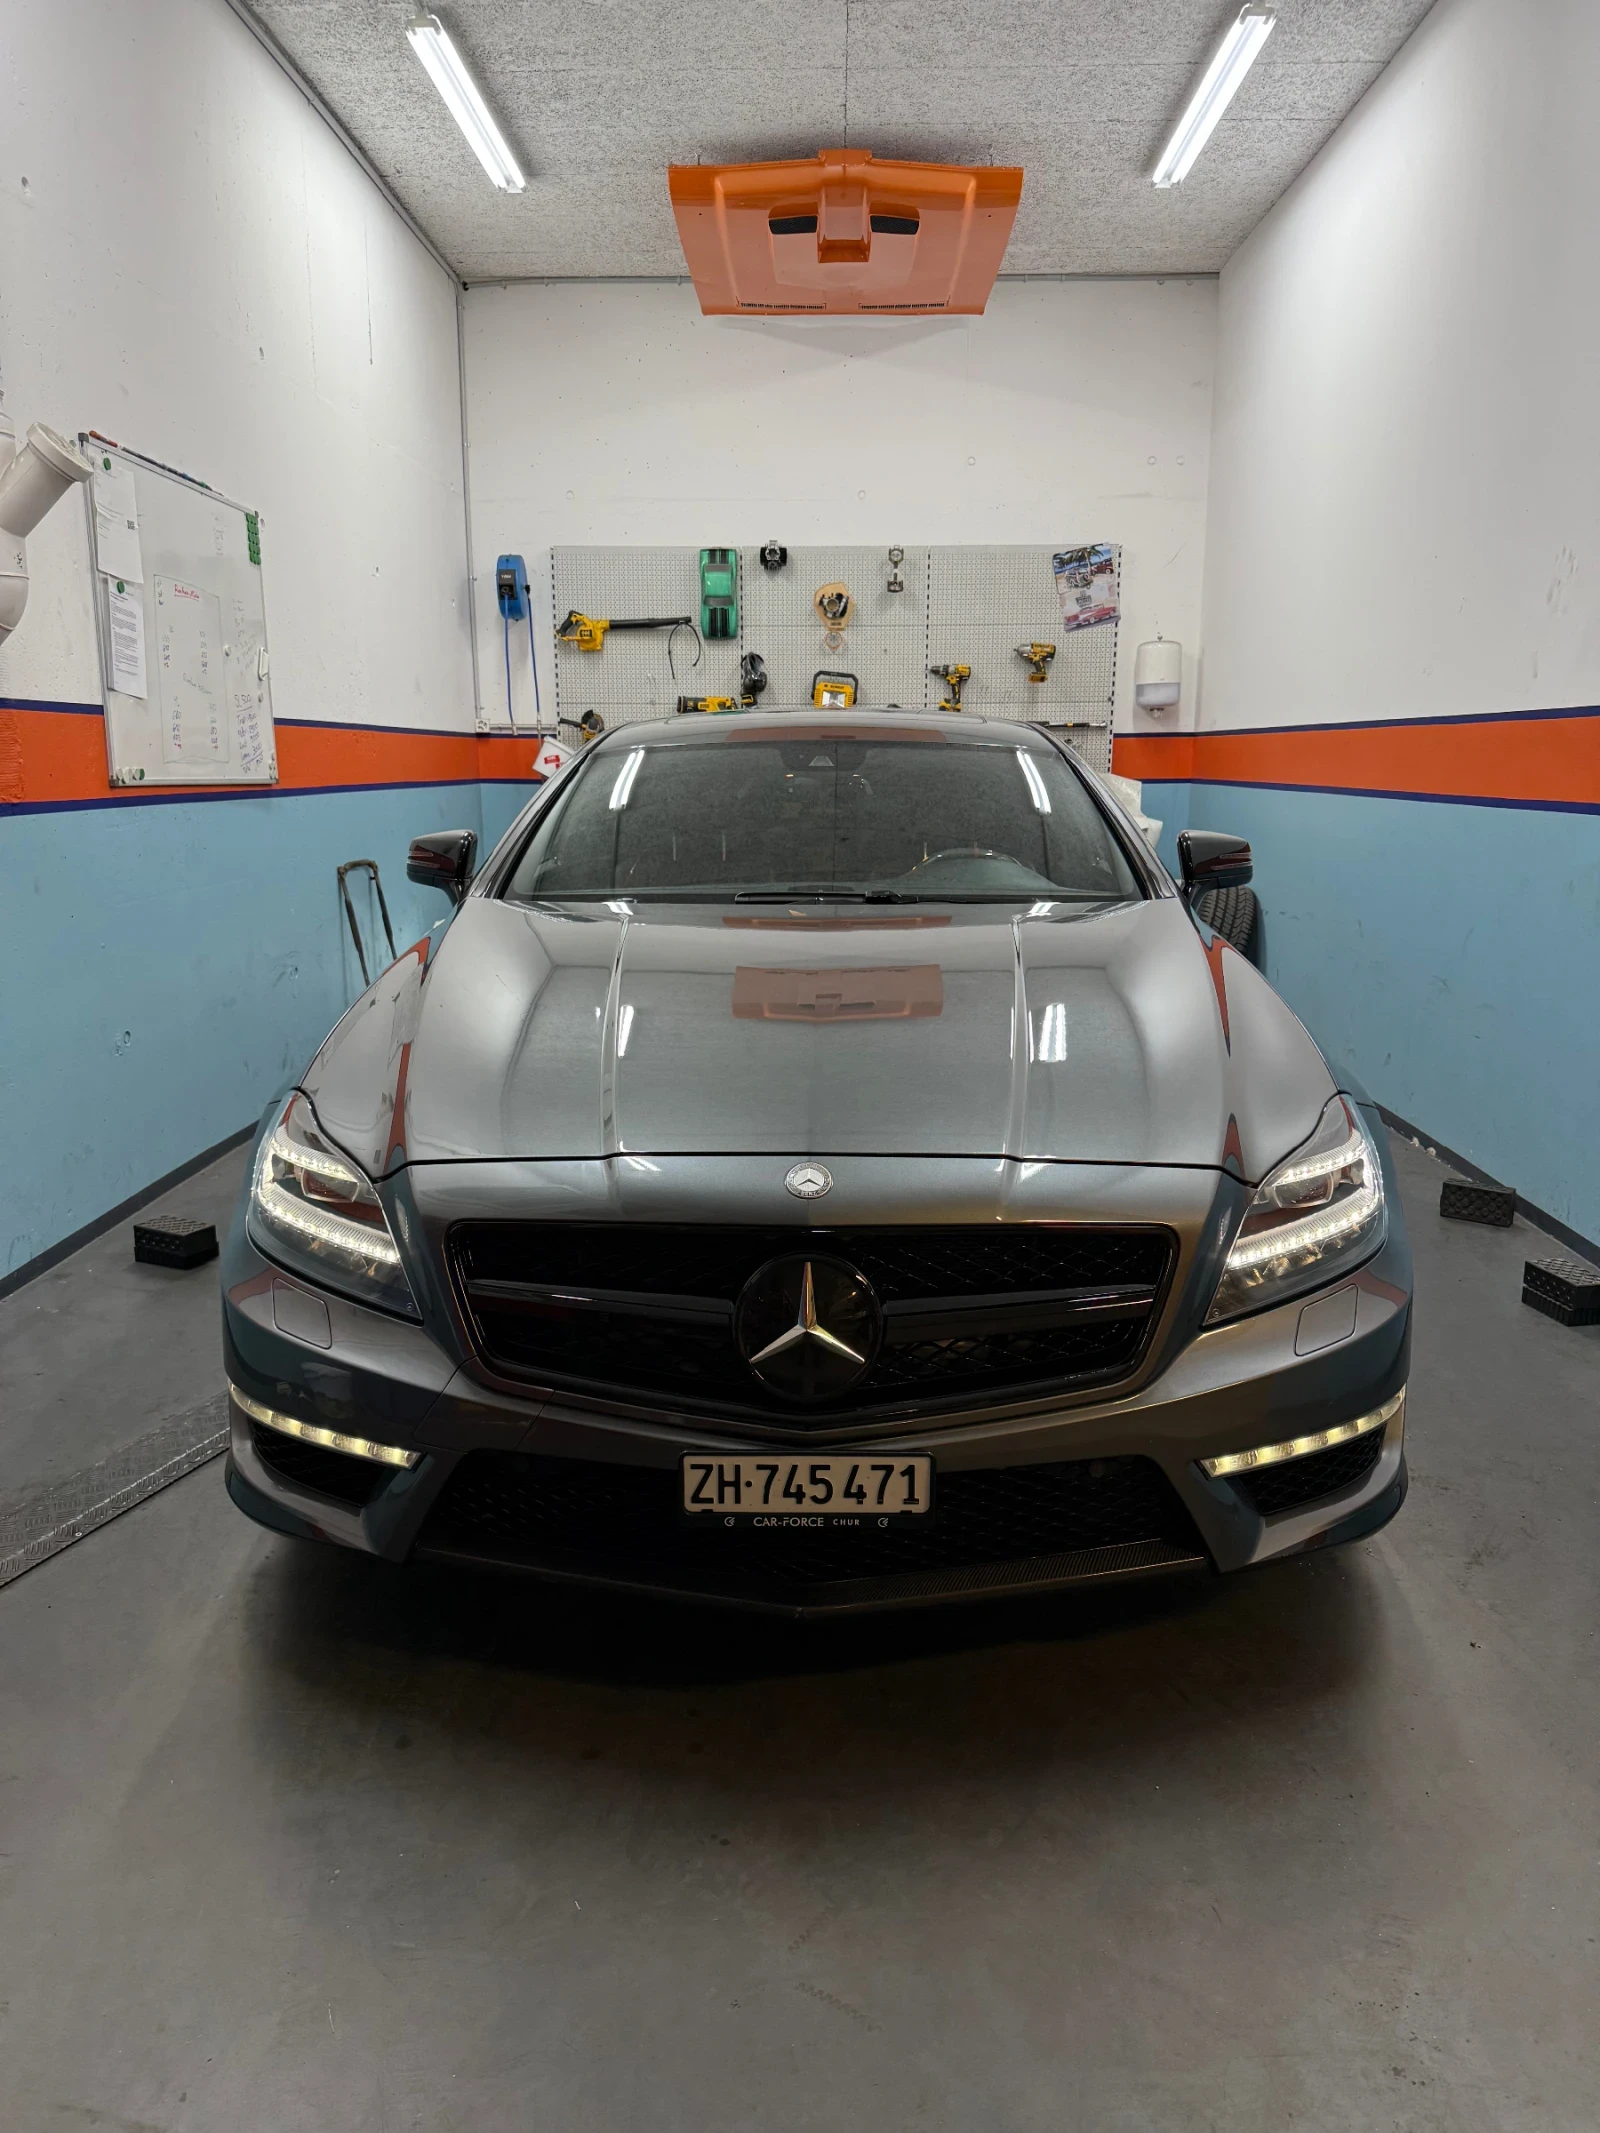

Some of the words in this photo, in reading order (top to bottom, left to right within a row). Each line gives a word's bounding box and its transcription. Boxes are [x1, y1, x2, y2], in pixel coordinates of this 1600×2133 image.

[843, 1464, 920, 1505] 471
[753, 1516, 824, 1527] CAR-FORCE
[832, 1518, 860, 1527] CHUR
